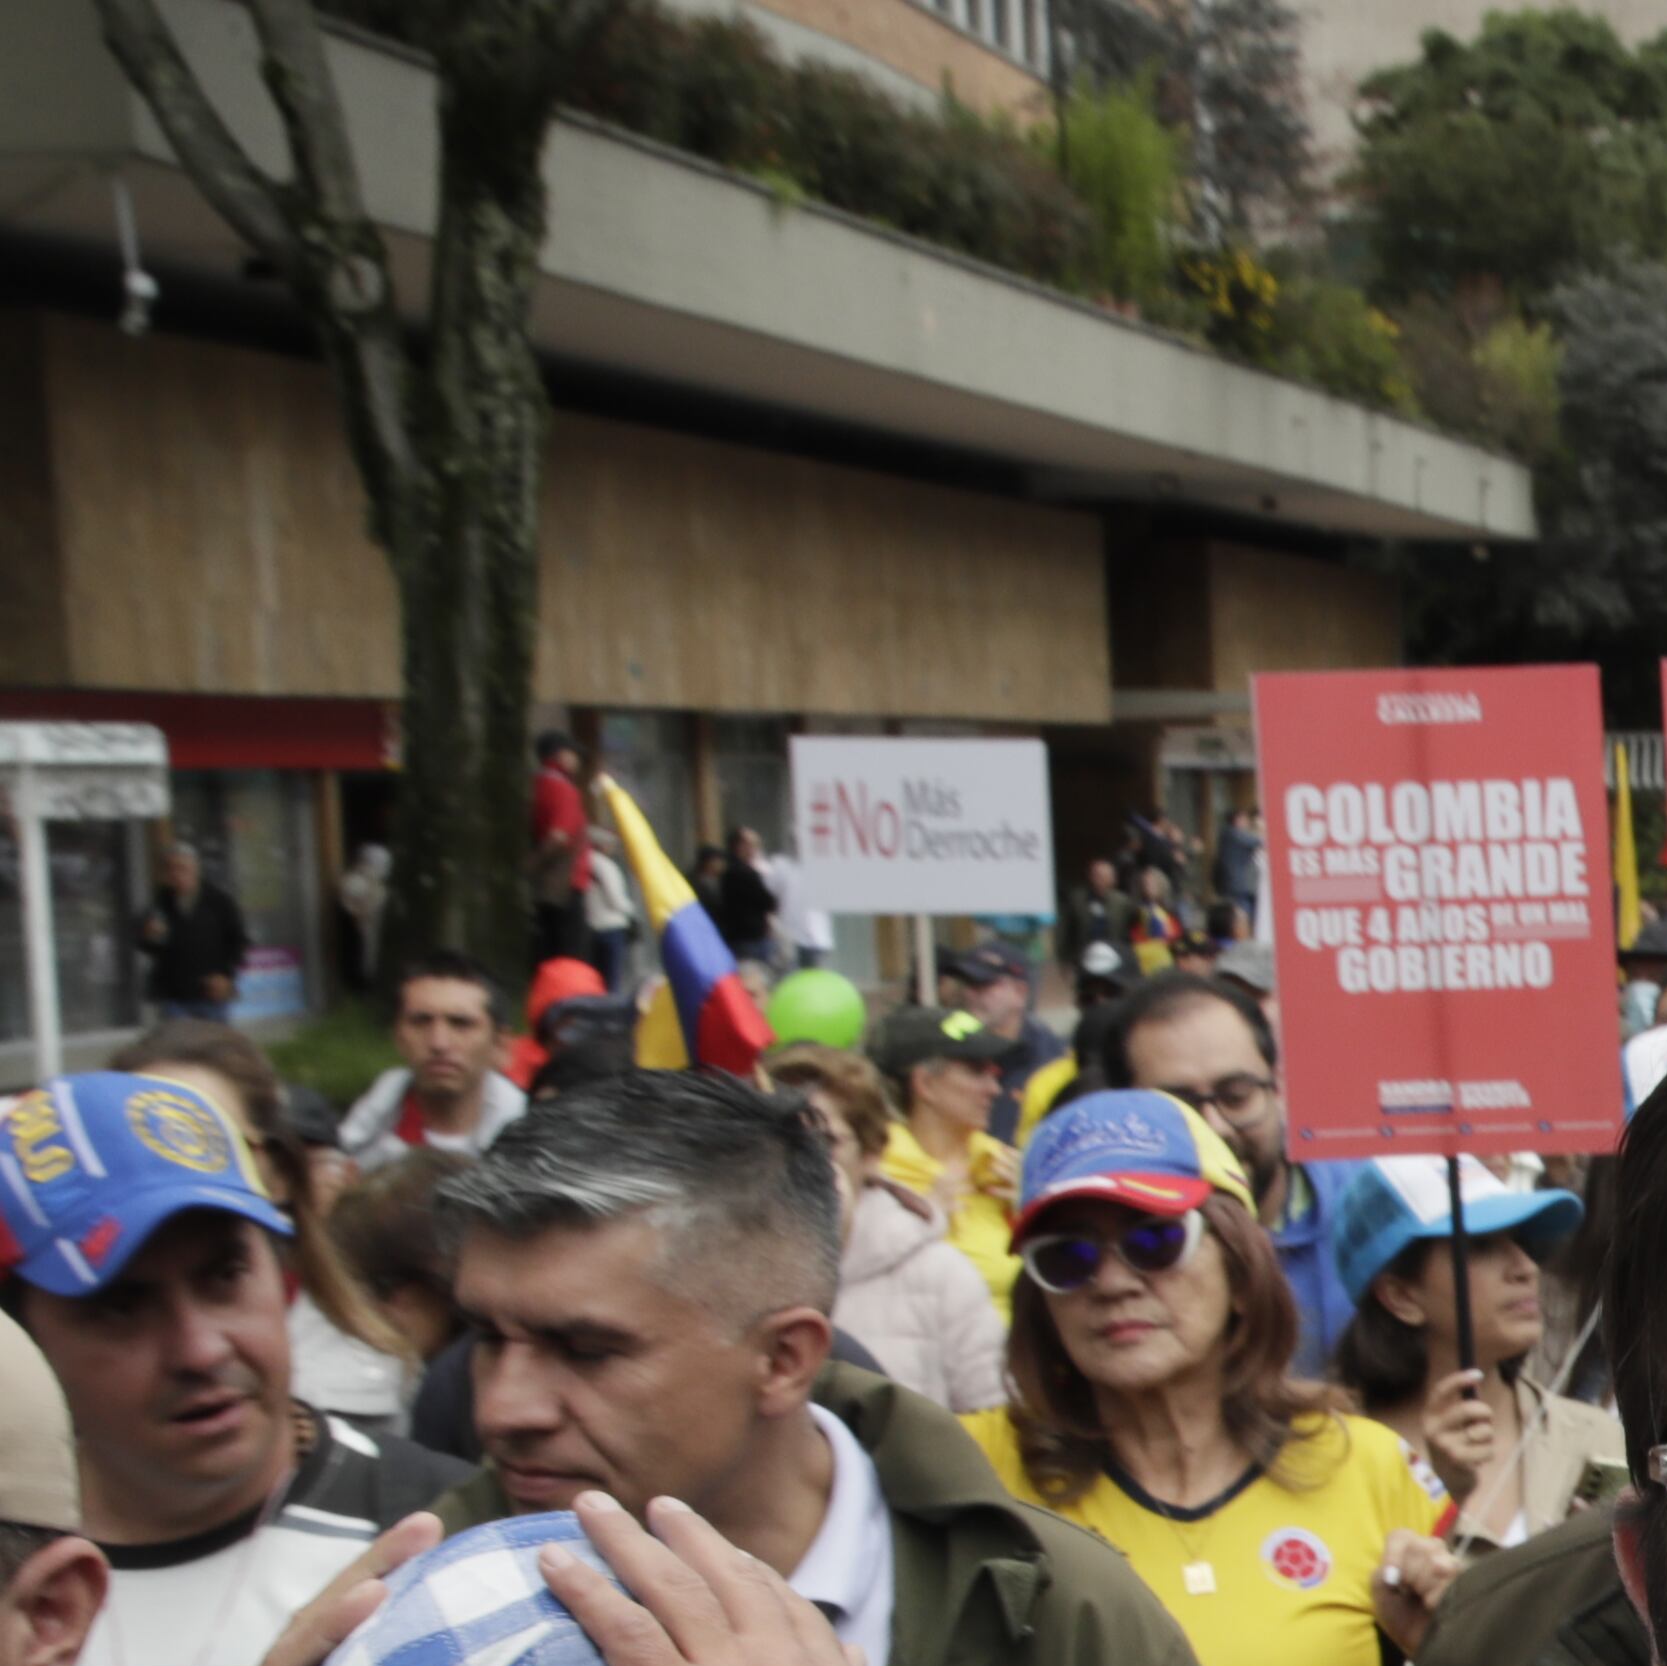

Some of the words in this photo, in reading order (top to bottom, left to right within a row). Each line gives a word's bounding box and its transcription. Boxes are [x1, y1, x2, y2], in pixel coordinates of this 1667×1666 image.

[811, 777, 900, 859] #No
[1284, 777, 1585, 847] COLOMBIA
[905, 820, 1041, 862] Derroche
[1289, 847, 1321, 877] ES
[1383, 841, 1589, 901] GRANDE
[1295, 906, 1362, 950] QUE
[1367, 905, 1392, 944] 4
[1396, 898, 1490, 944] AÑOS
[1336, 941, 1553, 993] GOBIERNO
